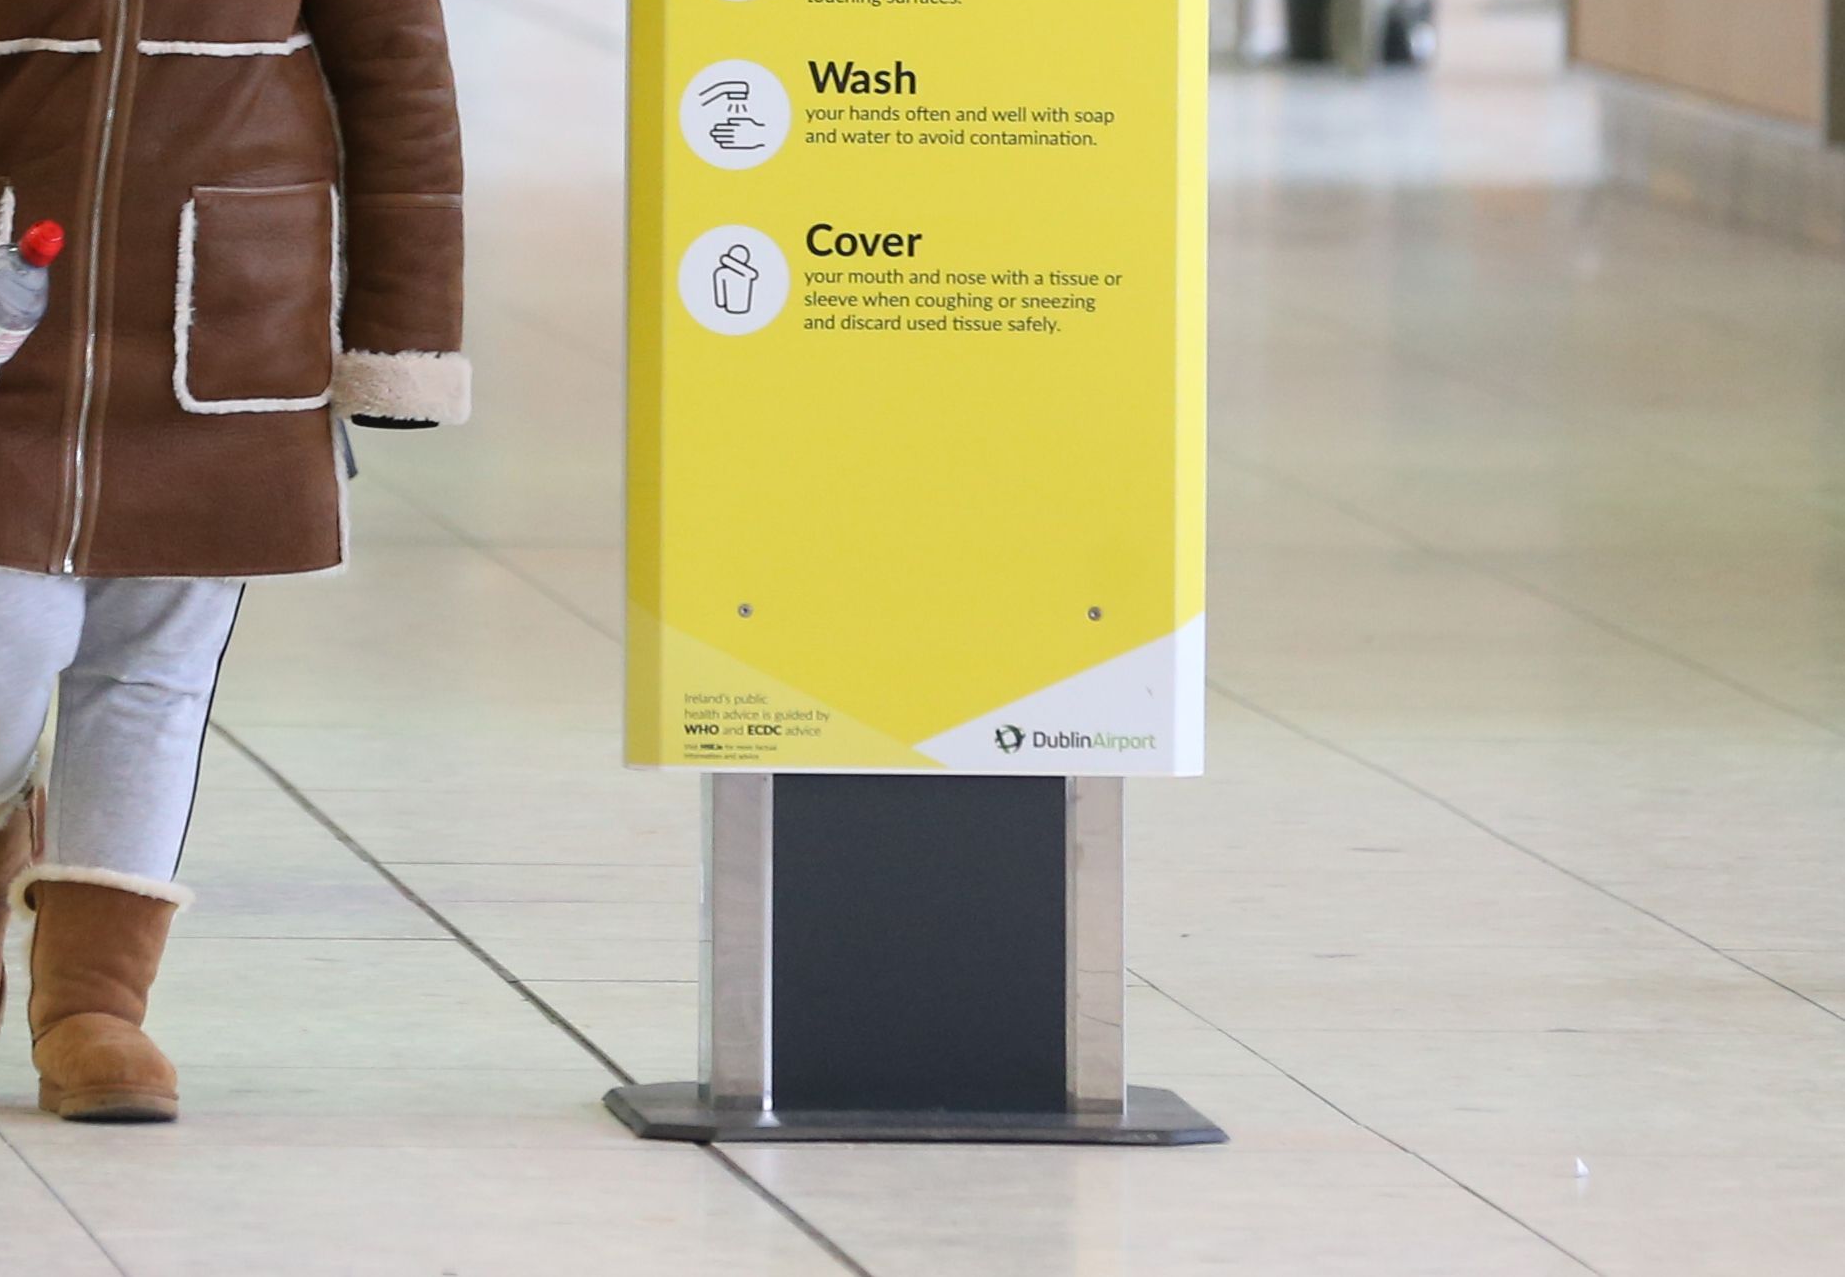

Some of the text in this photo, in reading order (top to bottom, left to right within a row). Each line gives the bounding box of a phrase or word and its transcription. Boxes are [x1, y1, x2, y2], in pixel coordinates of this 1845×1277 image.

[808, 61, 916, 94] Wash
[805, 105, 1114, 126] your hands often and well with soap
[805, 128, 1097, 146] and water to avoid contamination.
[807, 224, 922, 257] Cover
[804, 269, 1123, 286] your mouth and nose with a tissue or
[804, 291, 1096, 312] sleeve when coughing or sneezing
[804, 315, 1061, 334] and discard used tissue safely.
[684, 693, 768, 706] Ireland's public
[684, 708, 830, 723] health advice is guided by
[684, 725, 821, 736] WHO and ECDC advice
